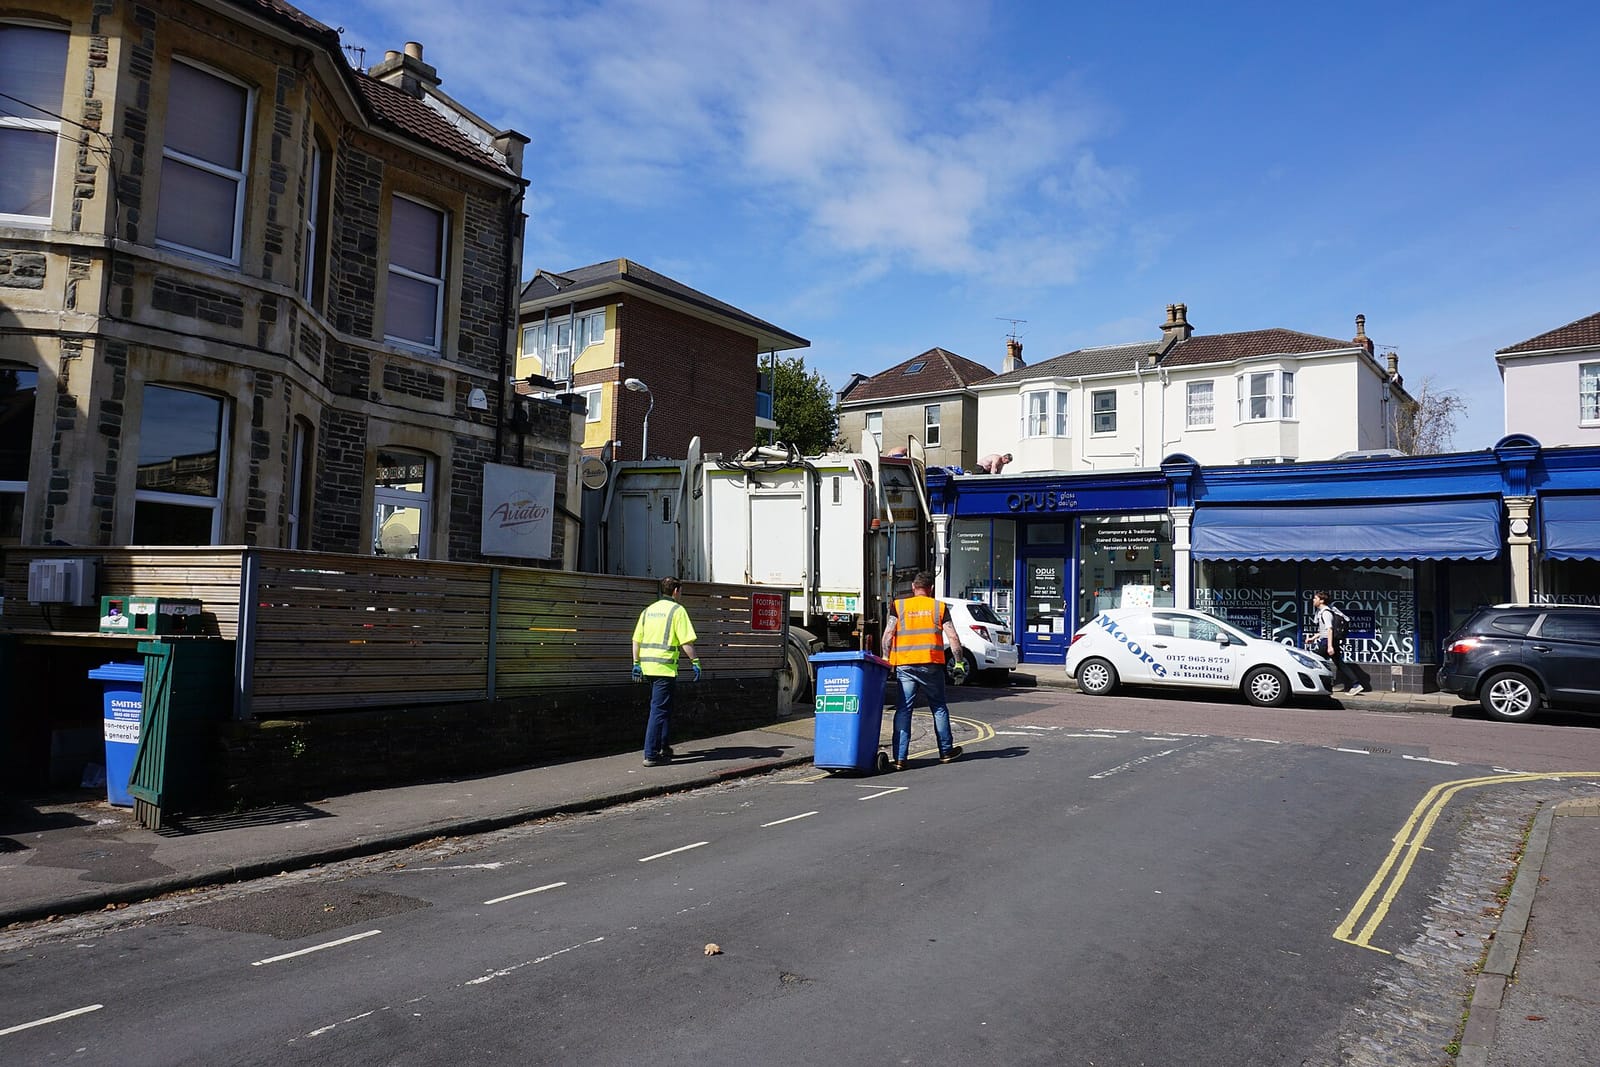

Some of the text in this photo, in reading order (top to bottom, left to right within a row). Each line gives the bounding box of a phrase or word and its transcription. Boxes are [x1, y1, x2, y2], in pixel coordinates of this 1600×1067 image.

[1007, 491, 1057, 511] OPUS
[488, 502, 550, 522] Aviator
[1035, 567, 1056, 576] opus
[1195, 588, 1271, 600] PENSIONS
[1302, 590, 1399, 600] GERATING
[1533, 594, 1600, 603] INVESTM
[759, 619, 777, 627] AHEAD
[1095, 613, 1168, 678] Moore
[1343, 651, 1414, 664] RITANCE
[1179, 664, 1223, 672] Roofing
[1183, 672, 1230, 681] Building
[111, 700, 142, 709] SMITHS
[109, 732, 132, 740] general
